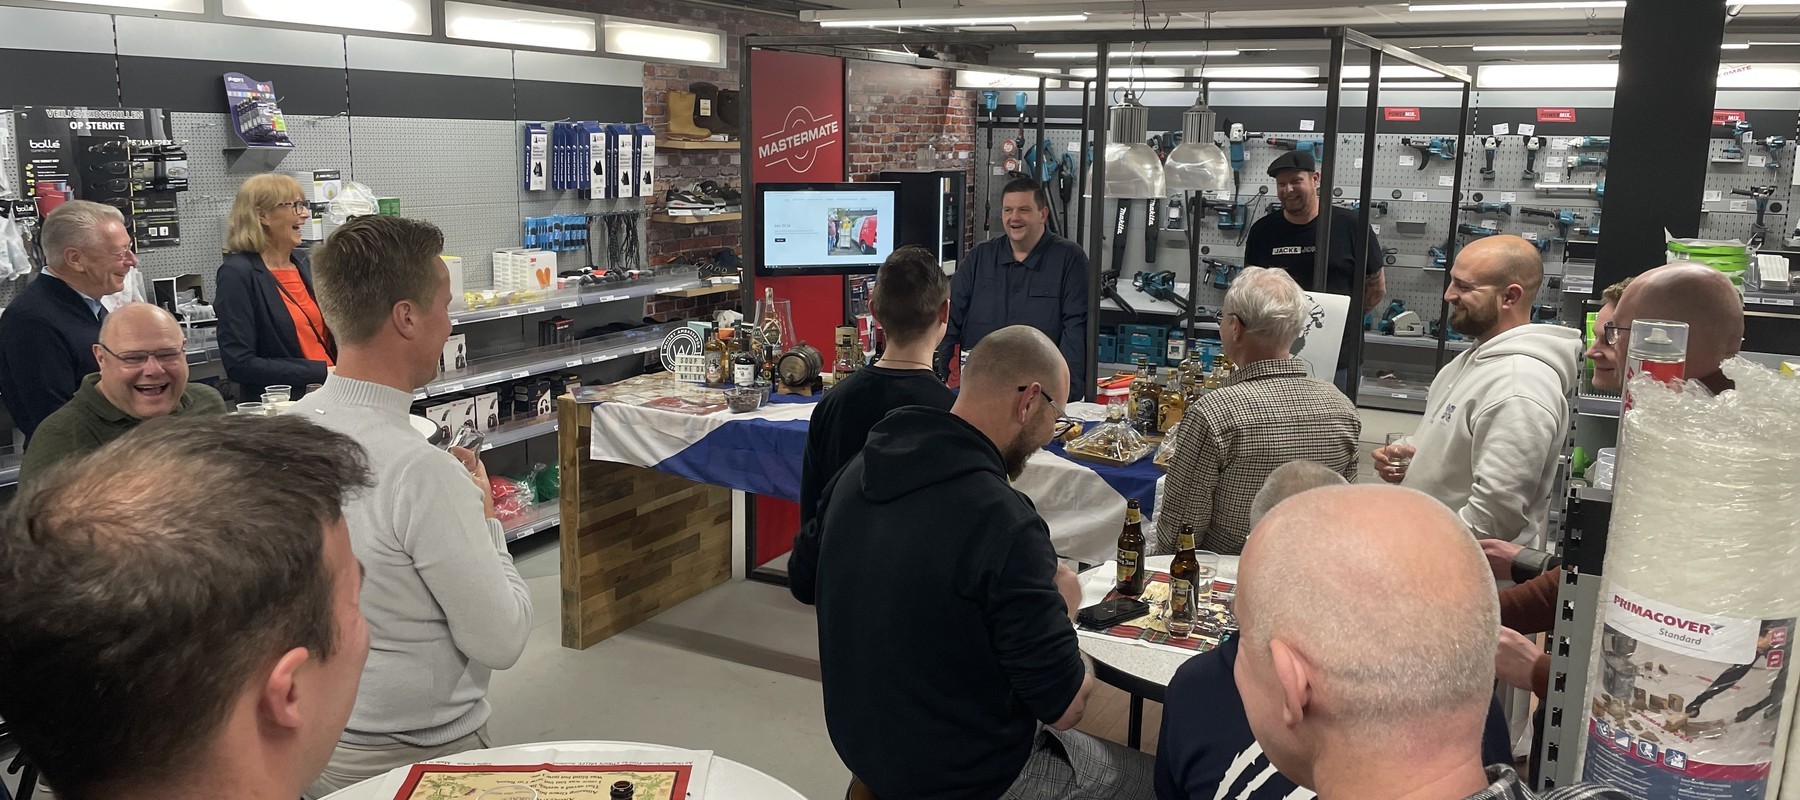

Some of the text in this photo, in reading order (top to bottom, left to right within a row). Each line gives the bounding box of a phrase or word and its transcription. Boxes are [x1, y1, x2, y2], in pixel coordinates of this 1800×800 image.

[70, 122, 125, 130] OP STERKTE
[30, 139, 60, 148] bollé
[758, 121, 838, 158] MASTERMATE
[1614, 594, 1711, 635] PRIMACOVER
[1659, 628, 1701, 646] Standard
